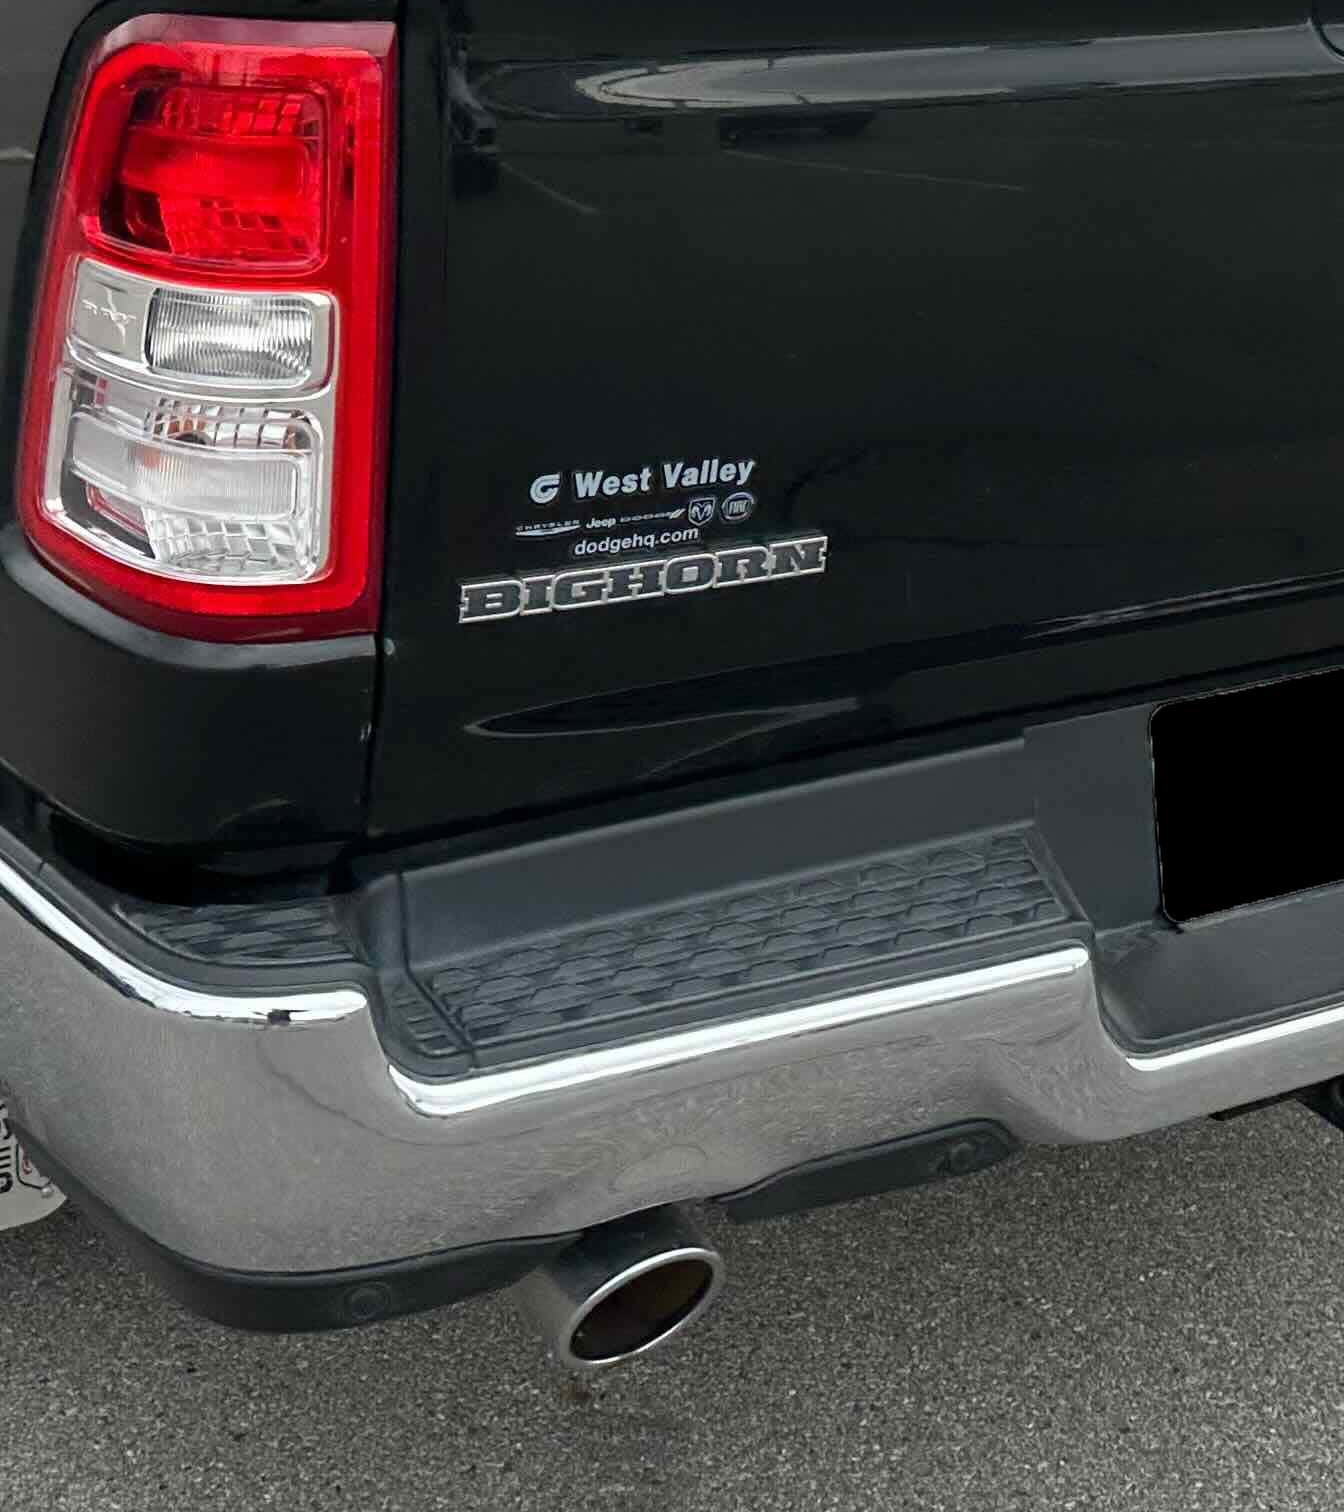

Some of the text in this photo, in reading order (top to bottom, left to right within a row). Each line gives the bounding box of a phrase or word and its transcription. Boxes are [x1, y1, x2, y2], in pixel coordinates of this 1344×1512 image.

[575, 459, 755, 498] West Valley
[585, 517, 616, 529] Jeep
[574, 527, 699, 556] dodgehq.com
[459, 536, 828, 624] BIGHORN
